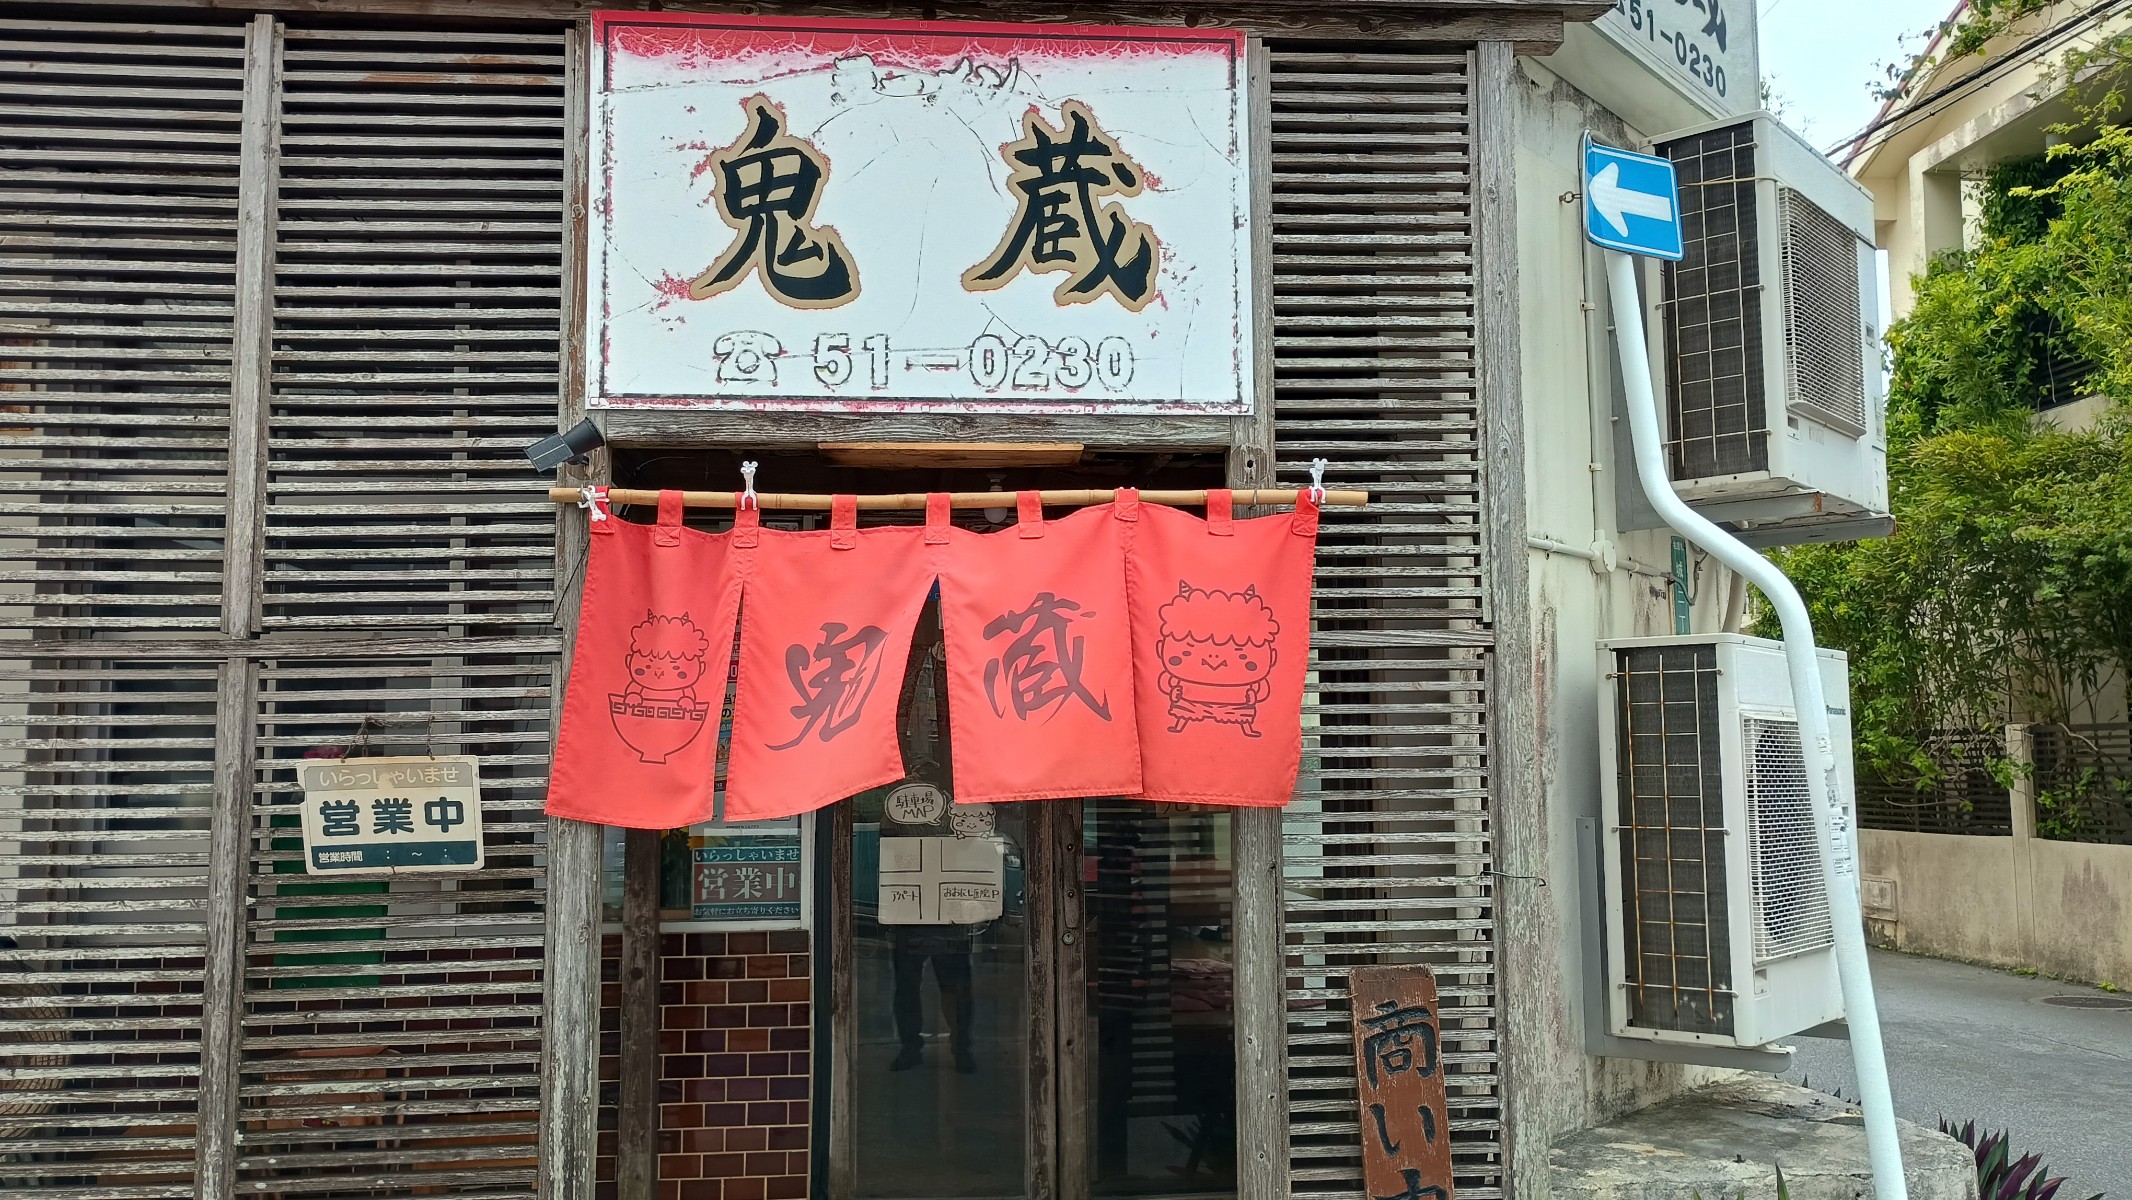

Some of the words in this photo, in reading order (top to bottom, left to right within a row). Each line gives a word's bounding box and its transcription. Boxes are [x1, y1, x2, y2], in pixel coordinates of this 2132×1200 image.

[319, 766, 460, 787] いらっしゃいませ
[895, 790, 935, 809] 駐車場
[319, 796, 465, 837] 営業中
[902, 804, 935, 820] MAP
[318, 850, 363, 864] 営業時間
[694, 848, 800, 862] いらっしゃいませ
[697, 867, 796, 900] 営業中
[891, 889, 918, 902] アパート
[693, 905, 800, 917] お気軽にお立ち寄りください
